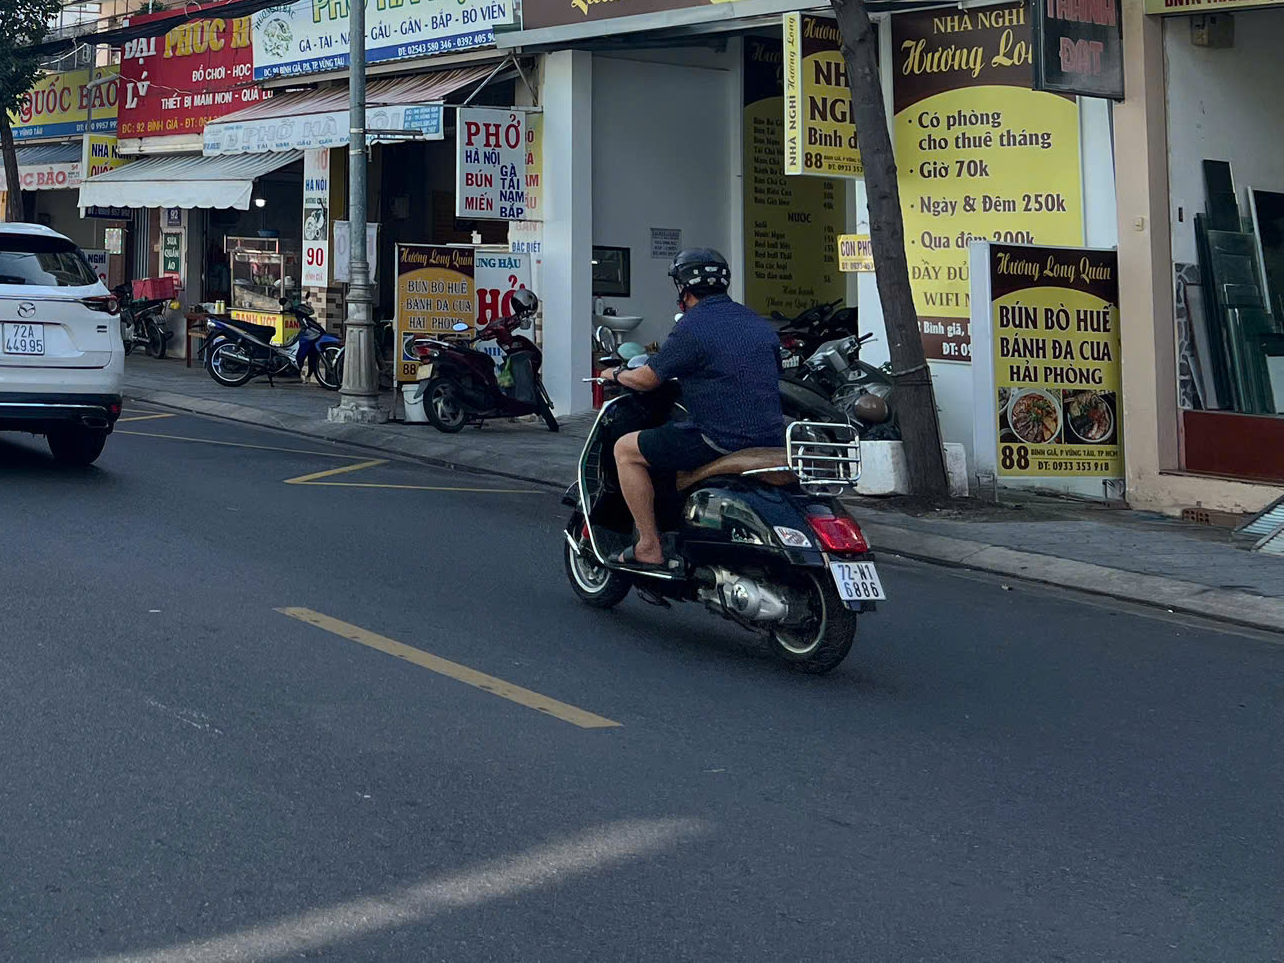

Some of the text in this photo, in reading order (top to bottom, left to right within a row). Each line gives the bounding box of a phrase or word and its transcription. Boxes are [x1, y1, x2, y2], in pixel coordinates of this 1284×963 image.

[462, 4, 478, 25] BÒ
[481, 0, 506, 21] VIÊN
[933, 1, 1026, 35] NHÀ NGHỈ
[123, 36, 157, 65] ĐẠI
[407, 43, 426, 55] 02543
[427, 41, 439, 52] 580
[440, 39, 452, 50] 346
[457, 35, 473, 47] 0392
[474, 33, 486, 44] 405
[900, 38, 985, 78] Hương
[232, 63, 251, 80] HỌC
[184, 96, 192, 110] BỊ
[215, 92, 233, 104] NON
[122, 123, 135, 134] ĐC:
[136, 122, 145, 133] 92
[185, 117, 197, 128] ĐT:
[918, 110, 1002, 130] Có phòng
[465, 114, 520, 149] PHỞ
[808, 127, 843, 148] Bình
[918, 129, 1052, 151] cho thuê tháng
[90, 142, 109, 158] NHÀ
[465, 147, 501, 168] HÀ NỘI
[804, 152, 823, 169] 88
[838, 164, 851, 172] 0933
[919, 159, 990, 179] Giờ 70k
[37, 166, 66, 187] BẢO
[465, 169, 493, 189] BÚN
[500, 163, 517, 178] GÀ
[316, 176, 327, 193] NỘI
[465, 191, 494, 212] MIẾN
[500, 190, 524, 205] NẠM
[919, 193, 1067, 217] Ngày & Đêm 250k
[170, 210, 179, 219] 92
[500, 203, 524, 219] BẮP
[920, 231, 951, 251] Qua
[88, 252, 107, 264] NGHỈ
[307, 247, 324, 267] 90
[400, 247, 473, 269] Hương Long Quán
[498, 256, 521, 270] HẬU
[911, 259, 969, 281] ĐẦY ĐỦ
[996, 252, 1111, 284] Hương Long Quán
[408, 279, 428, 294] BÚN
[431, 277, 444, 293] BÒ
[406, 296, 472, 312] BÁNH ĐA CUA
[924, 292, 960, 307] WIFI
[999, 300, 1111, 333] BÚN BÒ HUẾ
[13, 324, 34, 338] 72A
[923, 321, 965, 338] Bình giã,
[6, 338, 43, 353] 449.95
[942, 342, 959, 356] ĐT:
[1000, 332, 1112, 362] BÁNH ĐA CUA
[403, 363, 416, 375] 88
[1009, 359, 1103, 384] HẢI PHÒNG
[1001, 444, 1030, 470] 88
[1098, 449, 1104, 457] TP
[1105, 449, 1117, 457] HCM
[1038, 461, 1109, 471] ĐT: 0933 353 918
[837, 564, 874, 581] 72-N1
[843, 582, 879, 598] 6886
